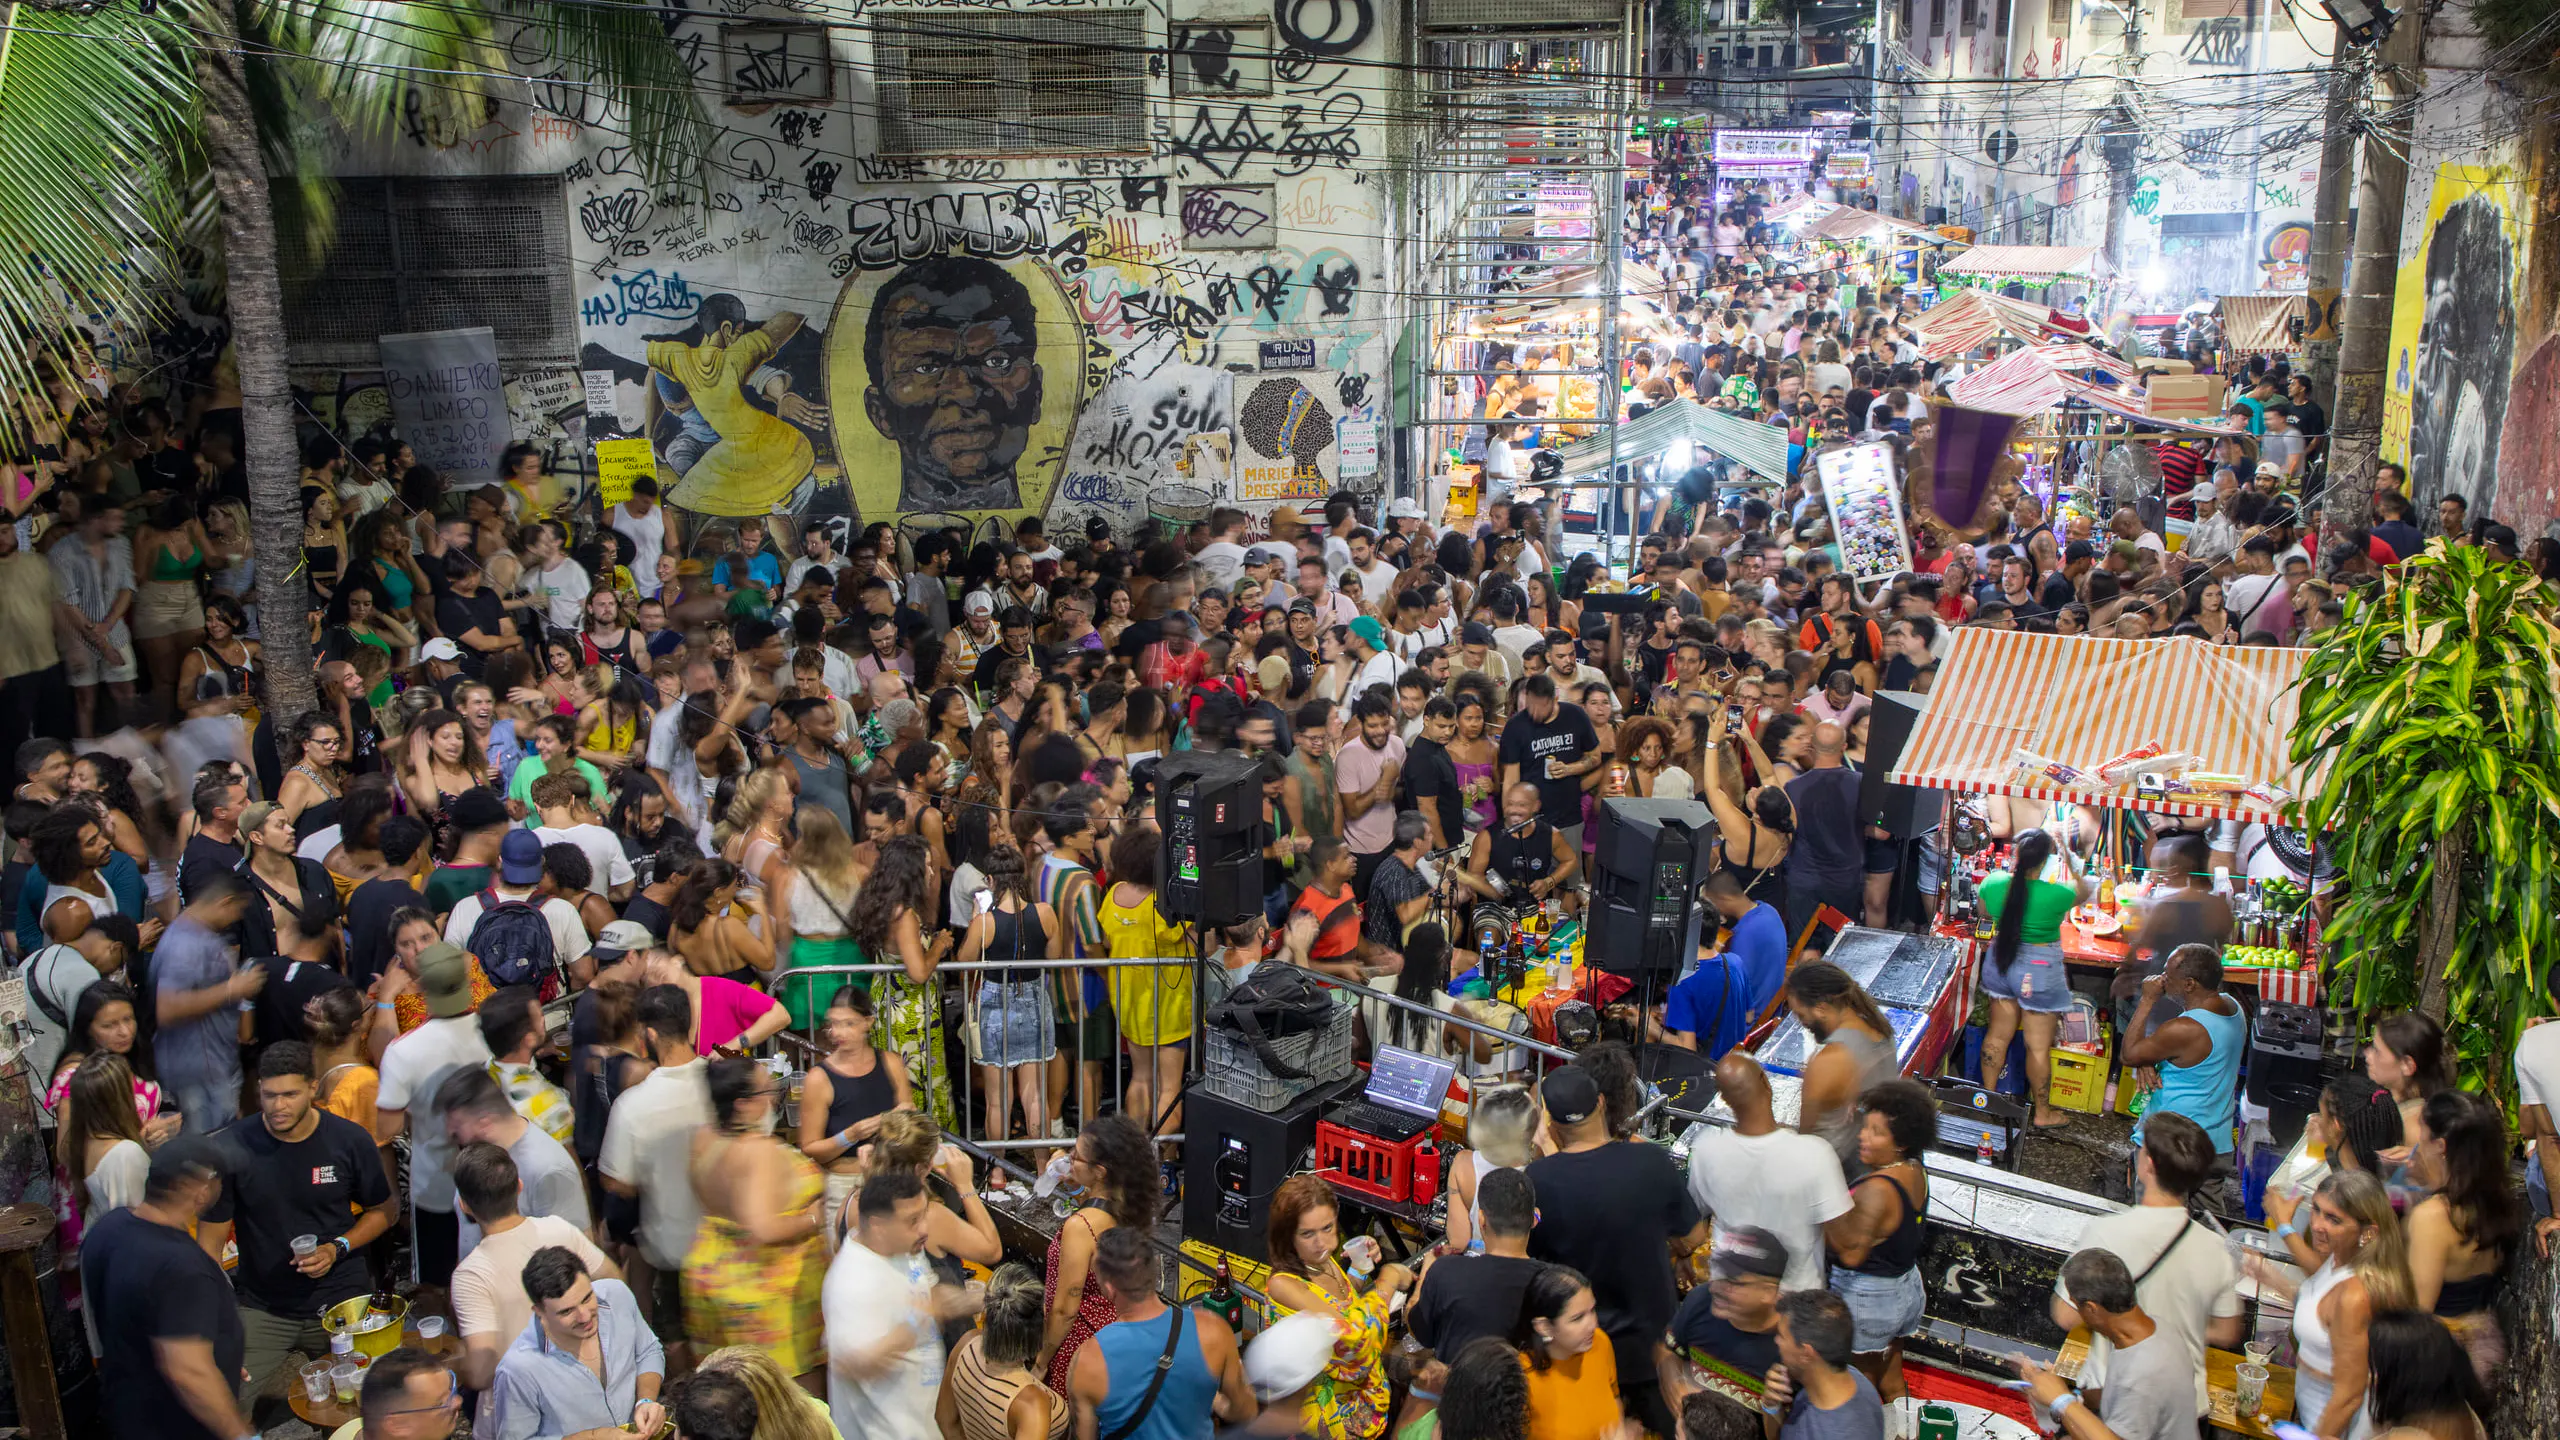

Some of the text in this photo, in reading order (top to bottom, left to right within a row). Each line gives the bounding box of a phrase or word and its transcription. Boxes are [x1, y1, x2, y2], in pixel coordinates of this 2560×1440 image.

[946, 159, 1005, 180] 2020
[676, 228, 770, 263] PEDRA DO SAL
[1274, 342, 1303, 354] RUA
[386, 362, 500, 400] BANHEIRO
[522, 368, 564, 384] CIDADE
[421, 397, 488, 421] LIMPO
[442, 421, 489, 444] 2,00
[436, 458, 490, 471] ESCADA
[1244, 465, 1316, 482] MARIELLE
[1531, 735, 1563, 752] CATUMBI
[320, 1176, 338, 1184] WALL
